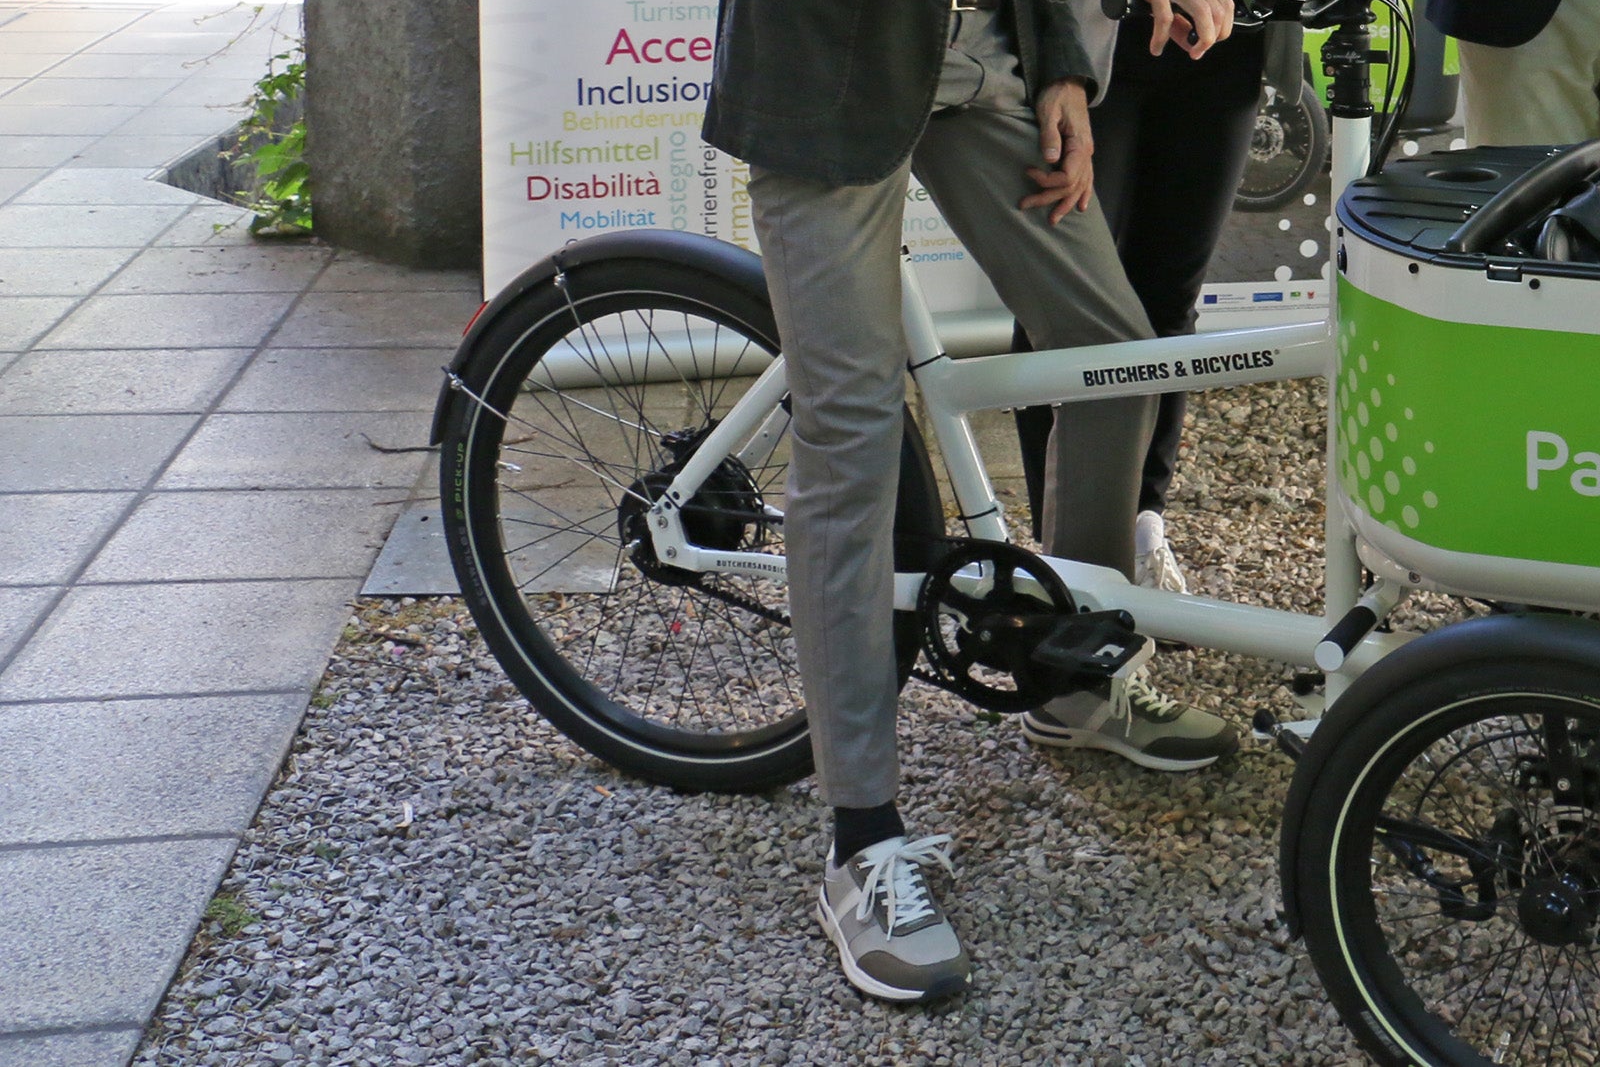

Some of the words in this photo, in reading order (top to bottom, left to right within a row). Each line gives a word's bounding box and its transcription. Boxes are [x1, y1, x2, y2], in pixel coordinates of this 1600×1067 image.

[510, 136, 660, 166] Hilfsmittel
[526, 171, 662, 202] Disabilità
[560, 208, 656, 230] Mobilität
[1083, 362, 1169, 387] BUTCHERS
[1174, 360, 1188, 377] &
